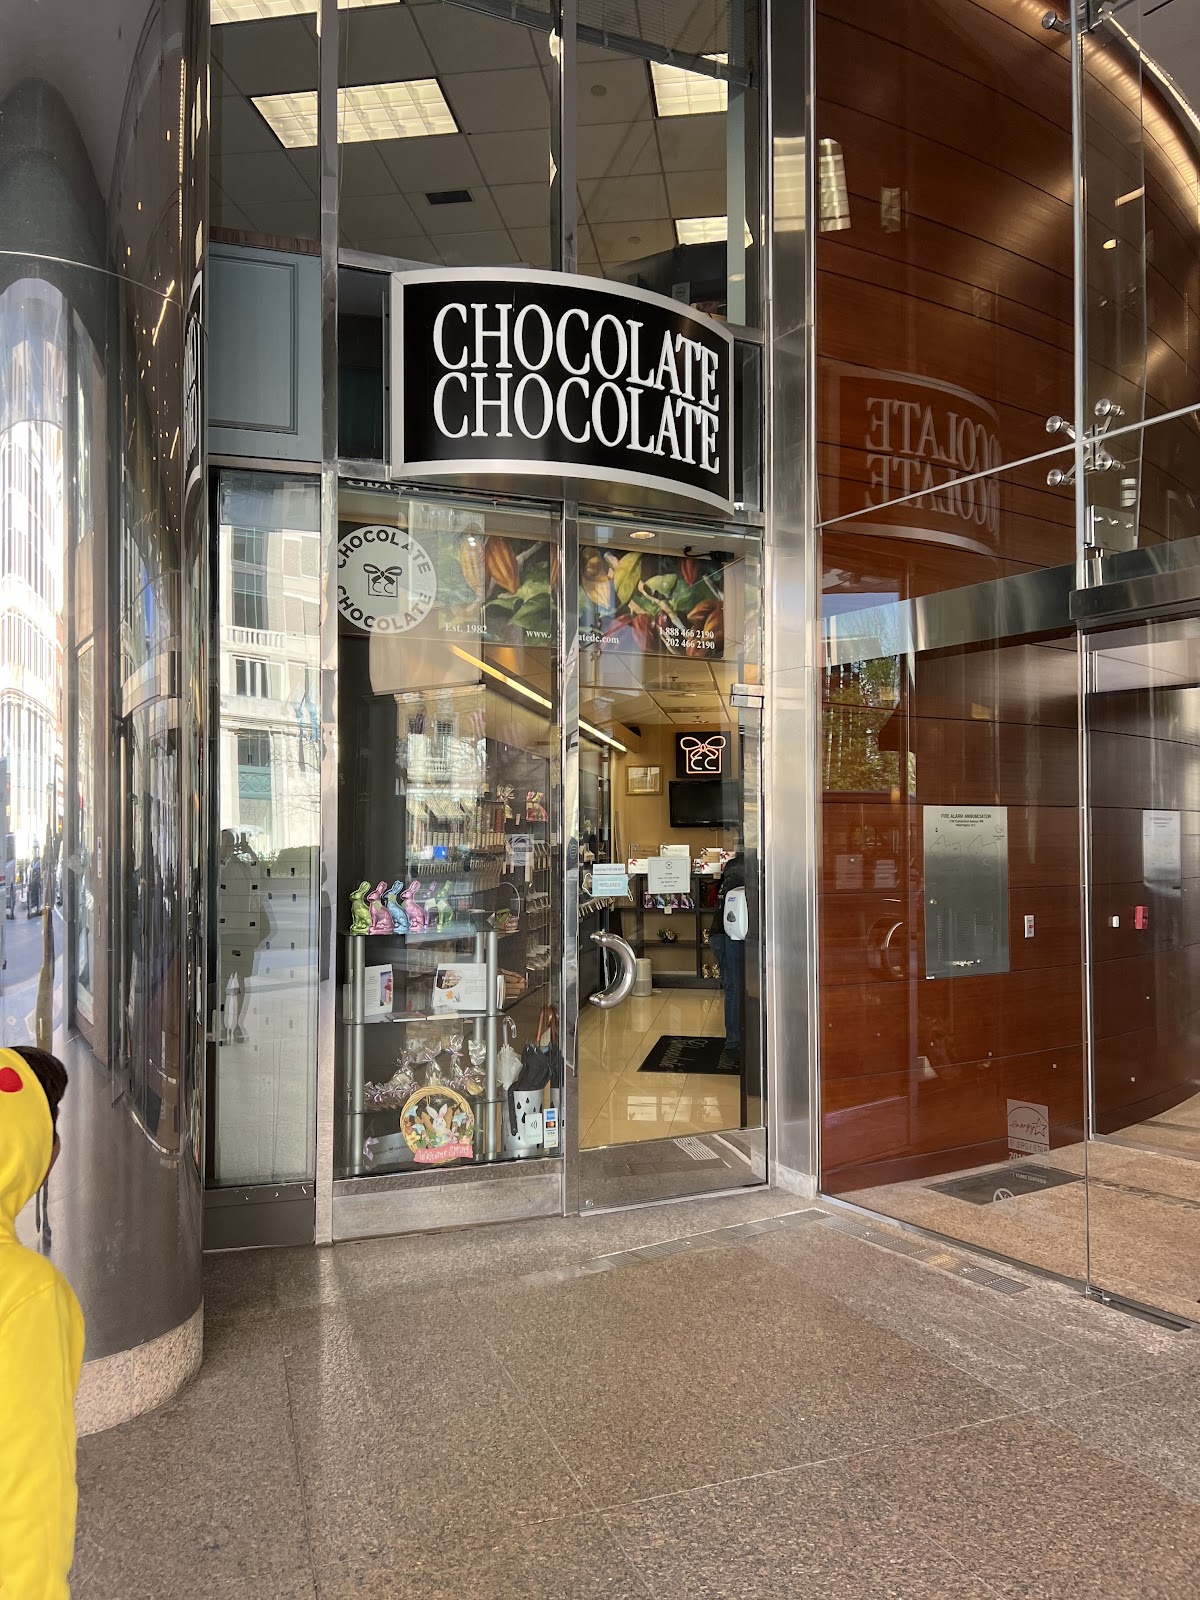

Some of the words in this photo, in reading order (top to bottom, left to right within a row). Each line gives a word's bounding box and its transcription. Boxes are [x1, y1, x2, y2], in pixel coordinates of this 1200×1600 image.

[433, 303, 719, 412] CHOCOLATE
[433, 372, 719, 475] CHOCOLATE
[338, 529, 432, 575] CHOCOLATE
[338, 584, 432, 632] CHOCOLATE
[445, 624, 463, 633] Est.
[466, 624, 488, 635] 1982
[665, 627, 680, 637] 888
[680, 629, 695, 638] 466
[696, 630, 715, 639] 2190
[665, 638, 680, 647] 202
[681, 639, 696, 648] 466
[696, 640, 716, 650] 2190
[418, 1150, 447, 1160] Welcome
[448, 1145, 469, 1157] Spring
[1010, 1140, 1033, 1150] ENERGY
[1033, 1145, 1048, 1153] STAR
